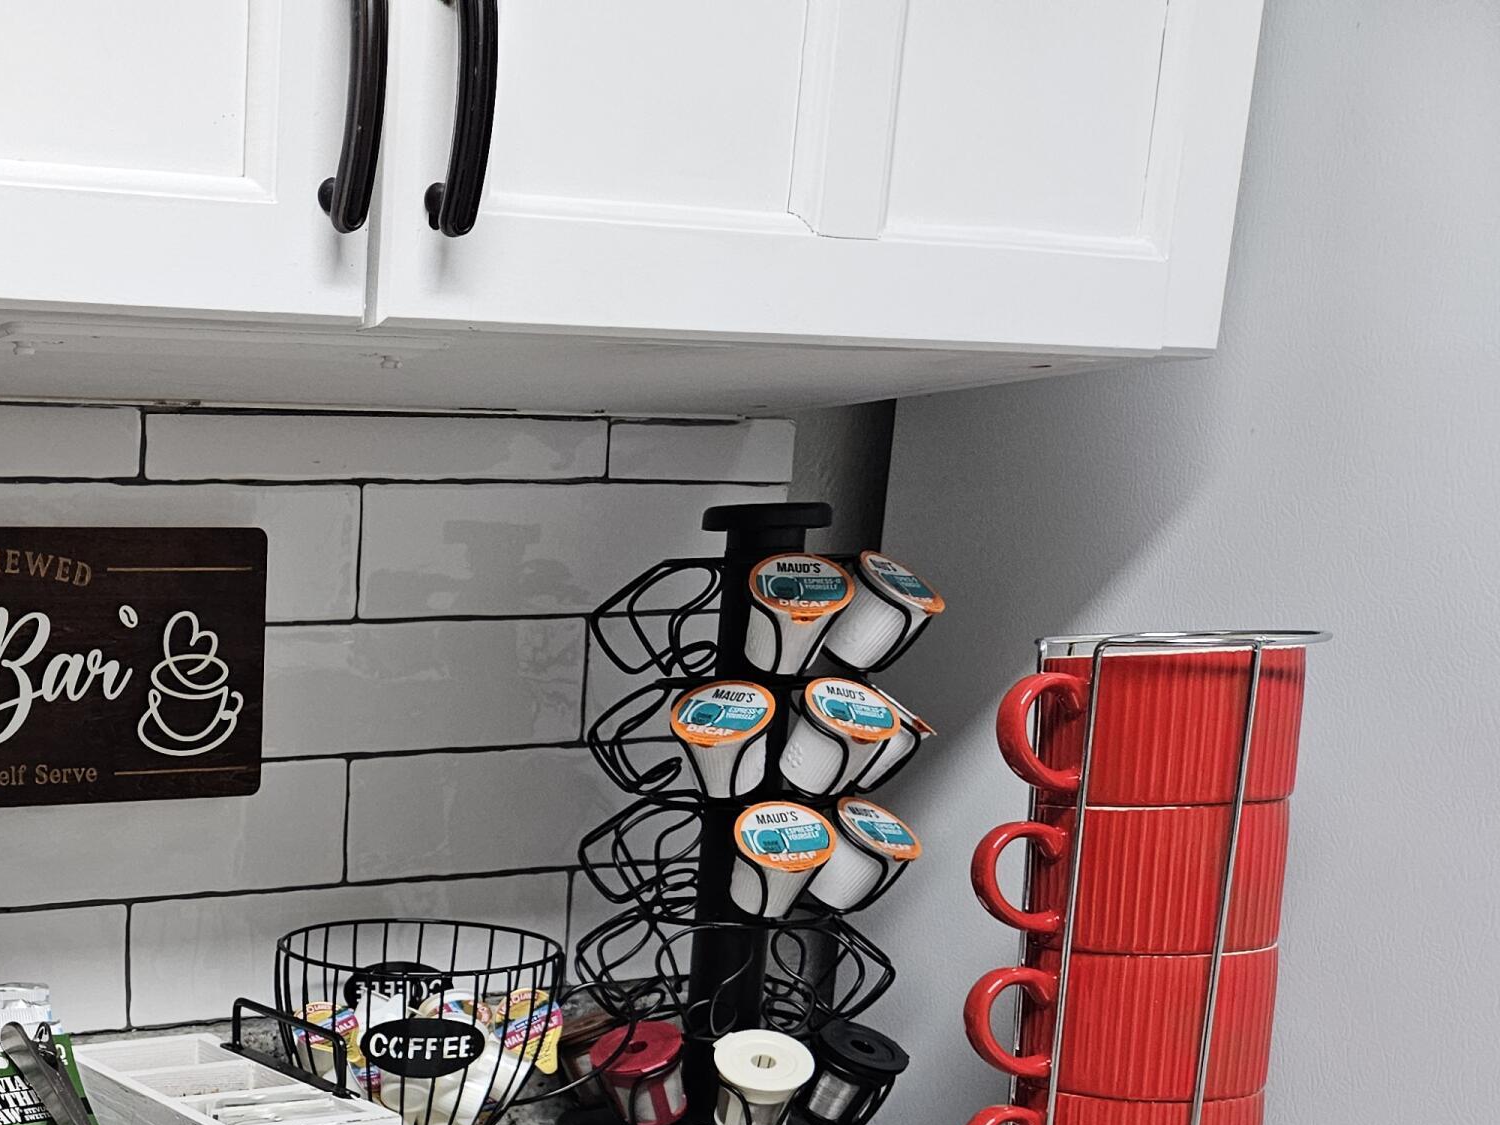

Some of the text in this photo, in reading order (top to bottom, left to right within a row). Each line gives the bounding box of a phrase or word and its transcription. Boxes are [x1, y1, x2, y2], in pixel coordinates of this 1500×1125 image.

[776, 562, 821, 574] MAUD'S
[712, 688, 756, 703] MAUD'S
[826, 685, 866, 701] MAUD'S
[35, 762, 98, 785] Serve
[755, 810, 799, 825] MAUD'S
[768, 850, 817, 862] DECAF
[369, 1033, 475, 1060] COFFEE
